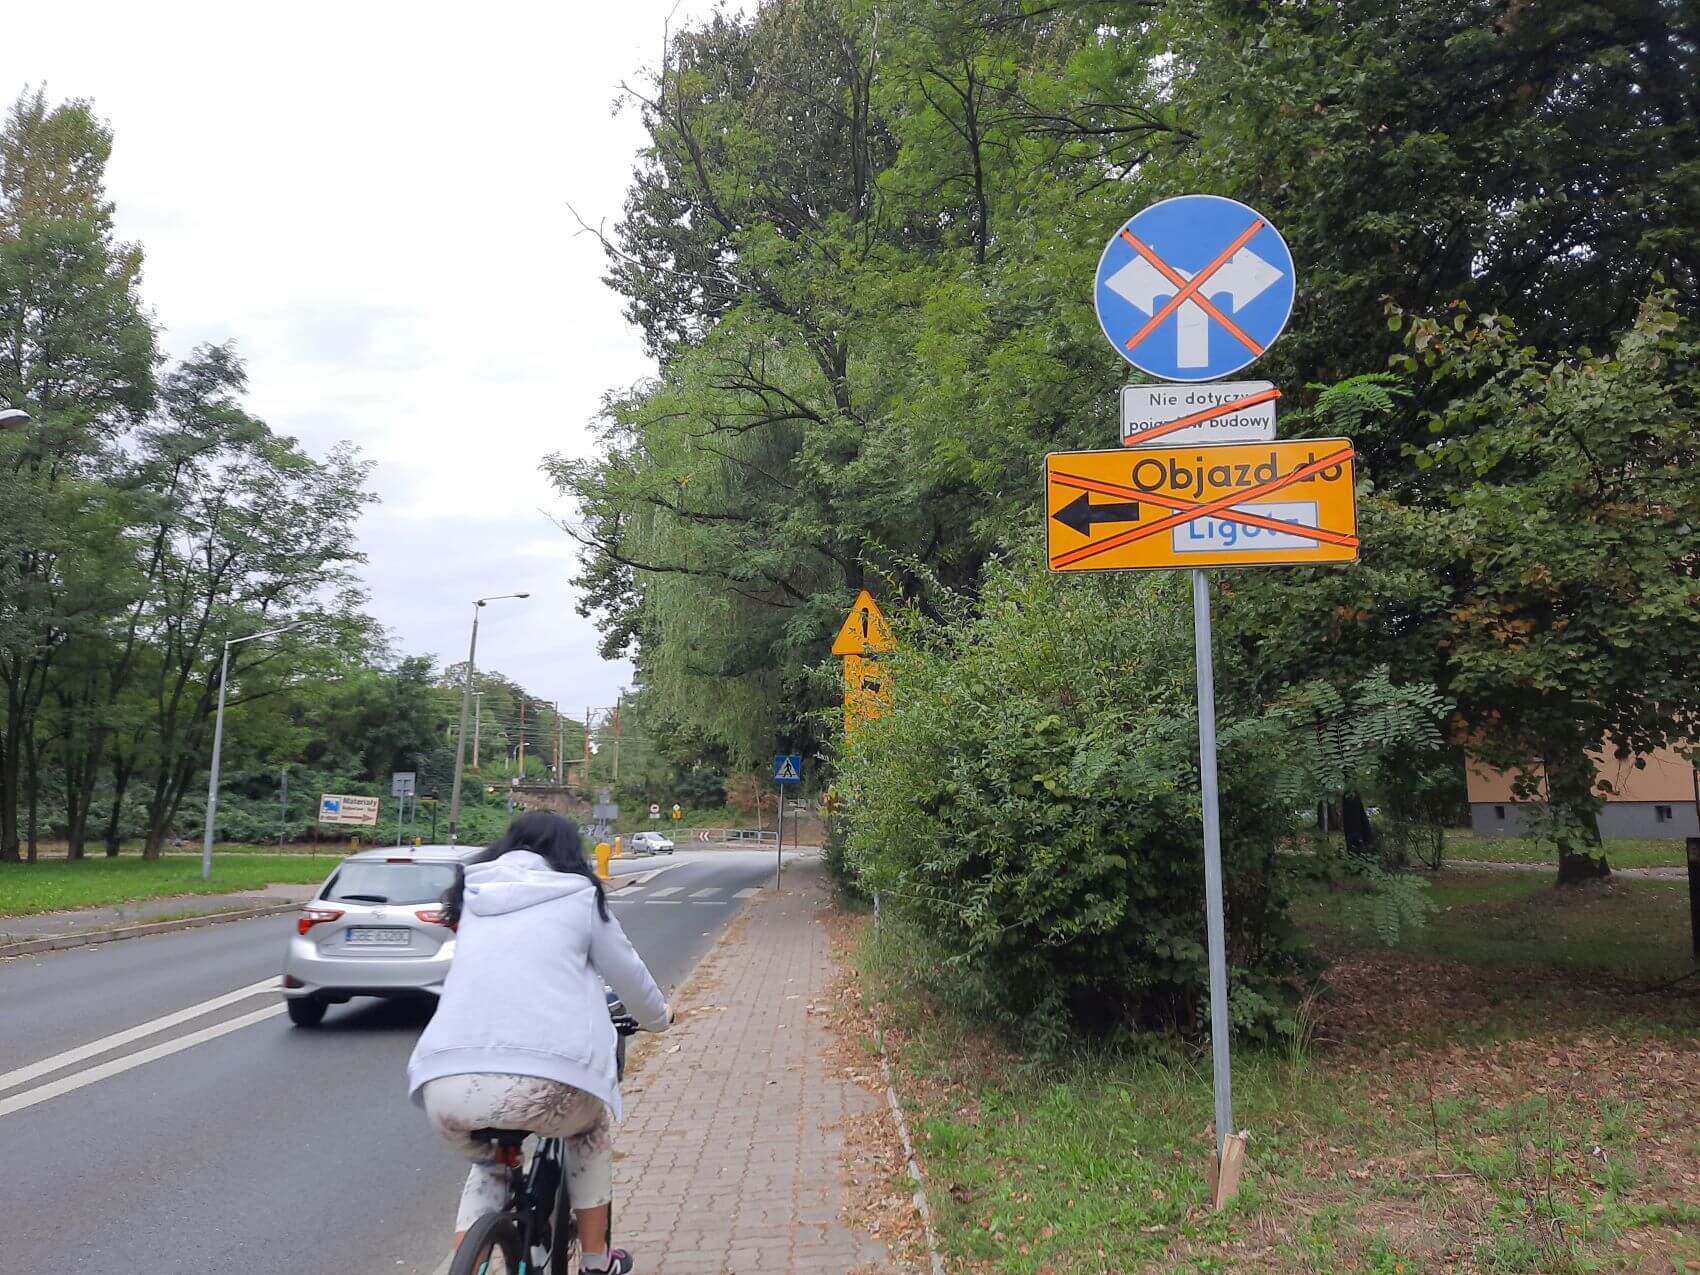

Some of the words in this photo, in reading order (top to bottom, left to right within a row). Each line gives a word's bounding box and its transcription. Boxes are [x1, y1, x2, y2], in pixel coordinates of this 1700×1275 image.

[1150, 392, 1177, 406] Nie
[1210, 415, 1270, 429] budowy
[1131, 452, 1278, 498] Objazd
